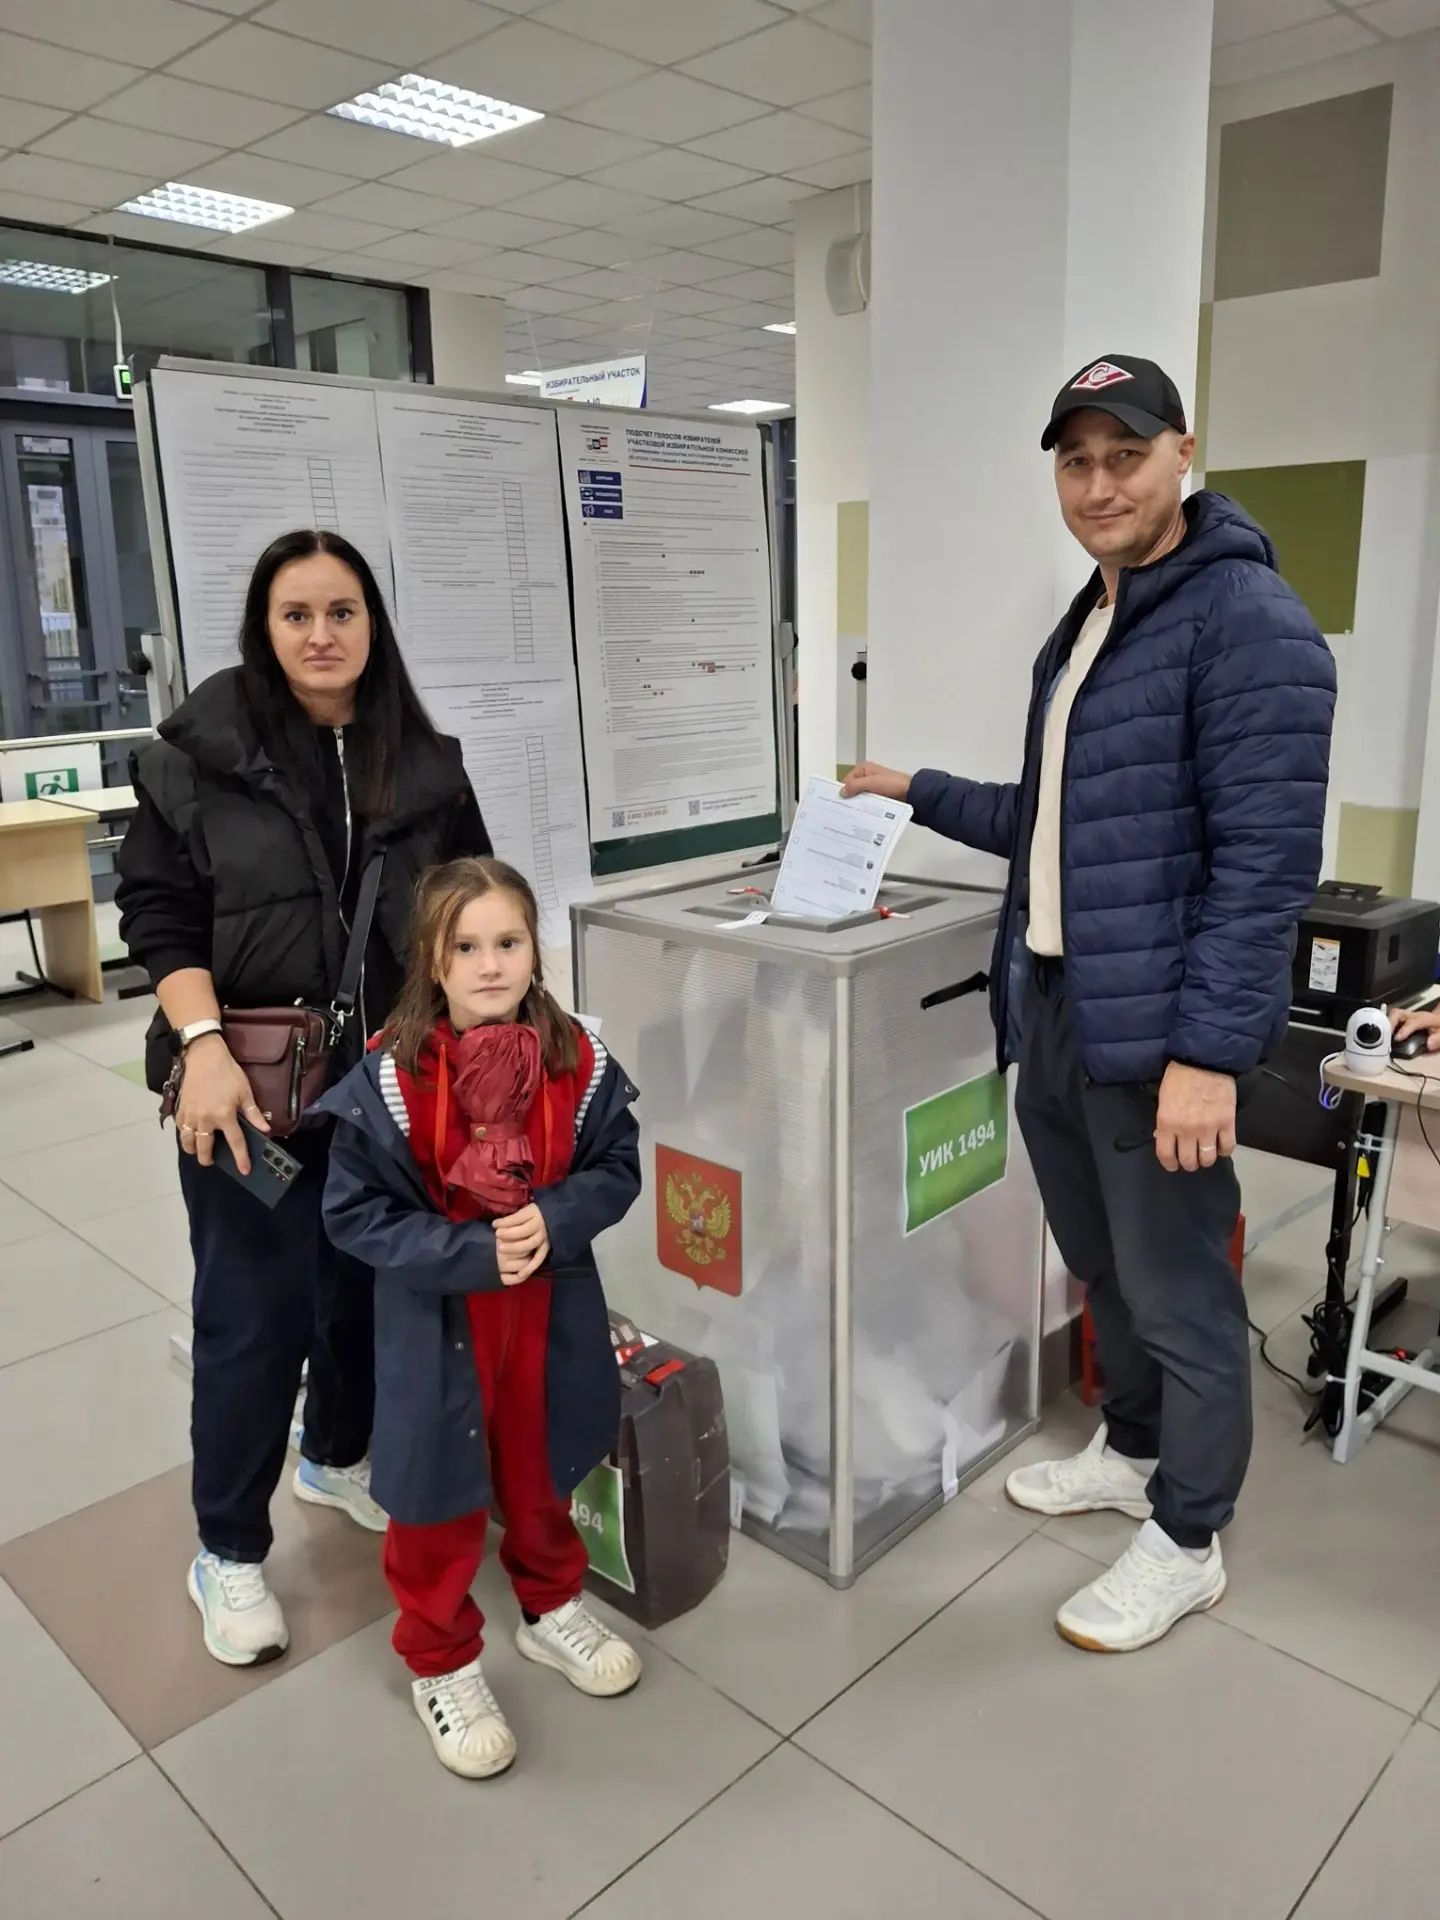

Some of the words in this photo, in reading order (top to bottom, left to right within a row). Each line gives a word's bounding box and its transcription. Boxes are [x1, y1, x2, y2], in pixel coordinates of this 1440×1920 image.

[546, 371, 605, 389] ИЗБИРАТЕЛЬНЫЙ
[607, 368, 640, 380] УЧАСТОК
[627, 439, 665, 448] УЧАСТКОВОЙ
[667, 442, 715, 453] ИЗБИРАТЕЛЬНОЙ
[654, 432, 681, 440] ГОЛОСОВ
[683, 434, 721, 444] ИЗБИРАТЕЛЕЙ
[919, 1140, 954, 1177] УИК
[958, 1120, 996, 1157] 1494
